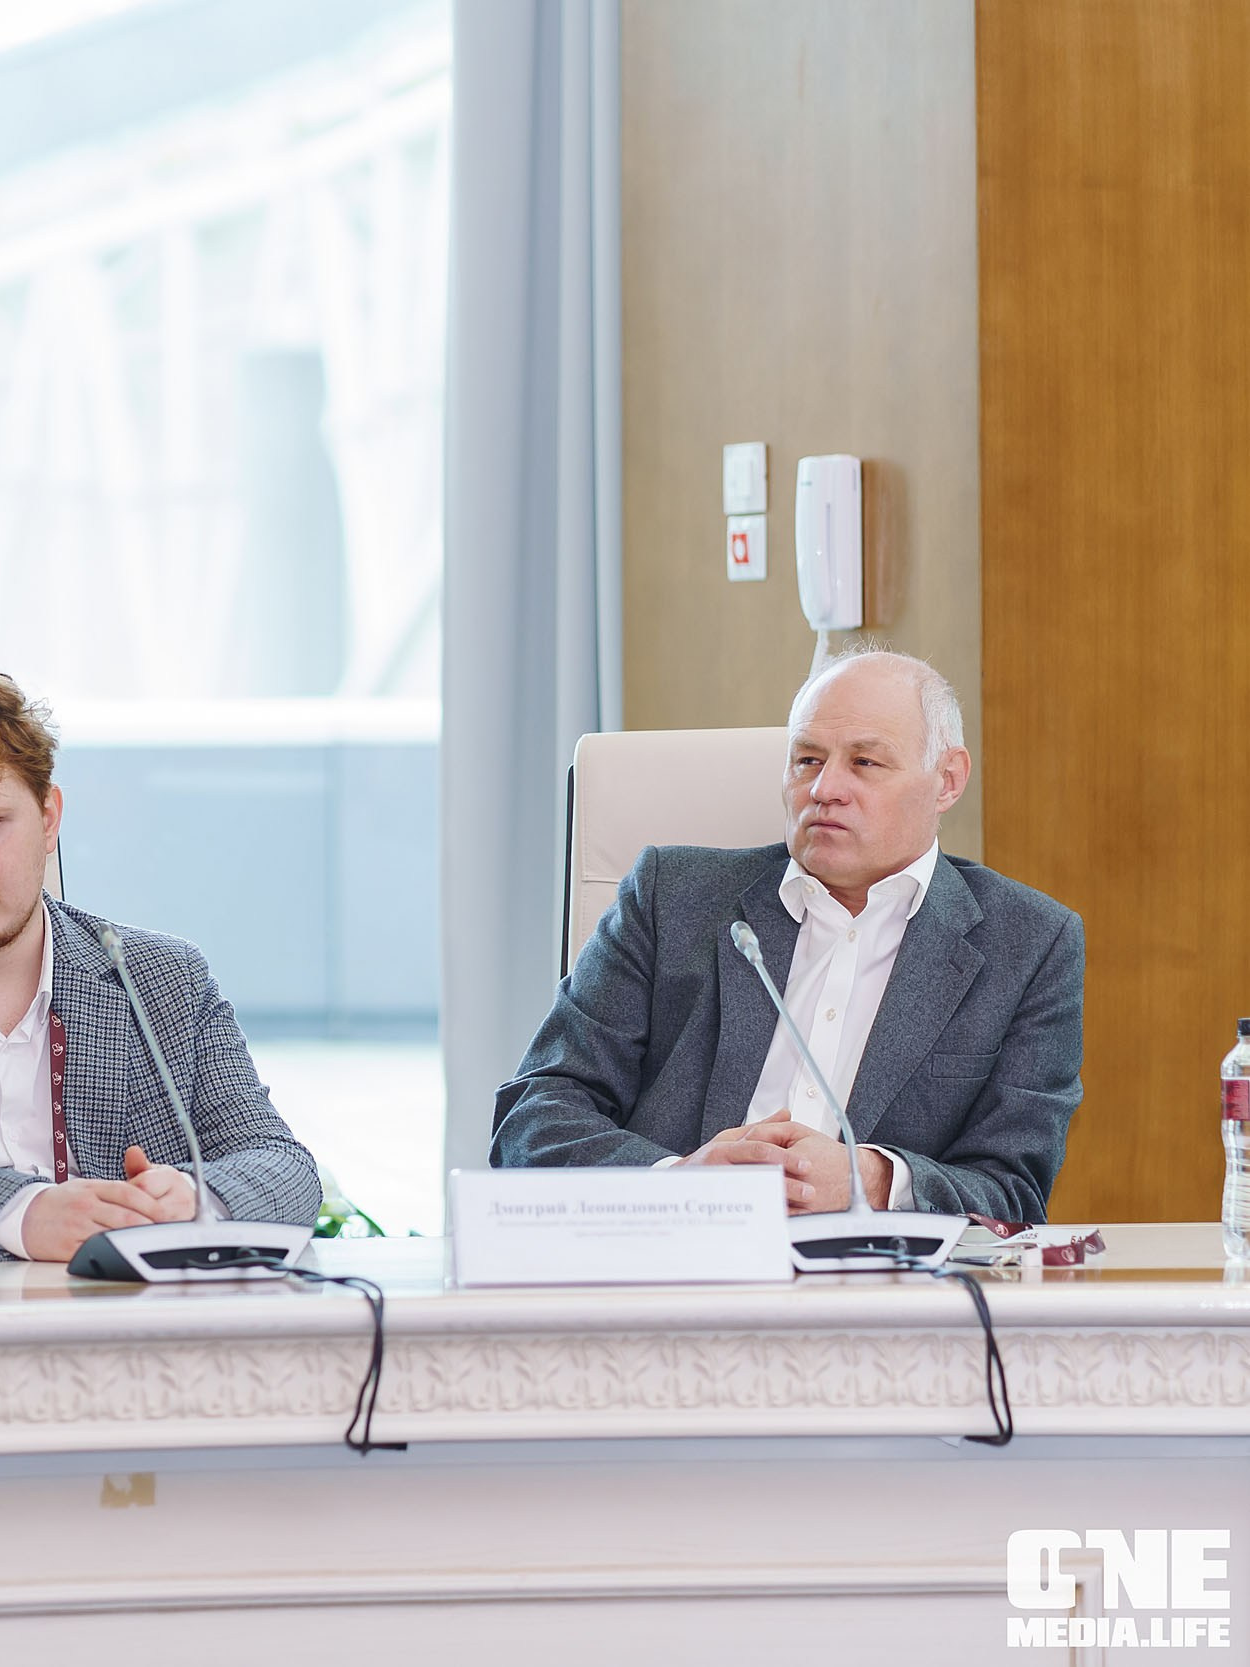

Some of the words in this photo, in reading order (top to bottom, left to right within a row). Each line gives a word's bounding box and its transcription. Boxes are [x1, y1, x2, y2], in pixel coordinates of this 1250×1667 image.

[487, 1200, 567, 1217] Дмитрий
[572, 1200, 679, 1215] Леонидович
[685, 1199, 753, 1216] Сергеев
